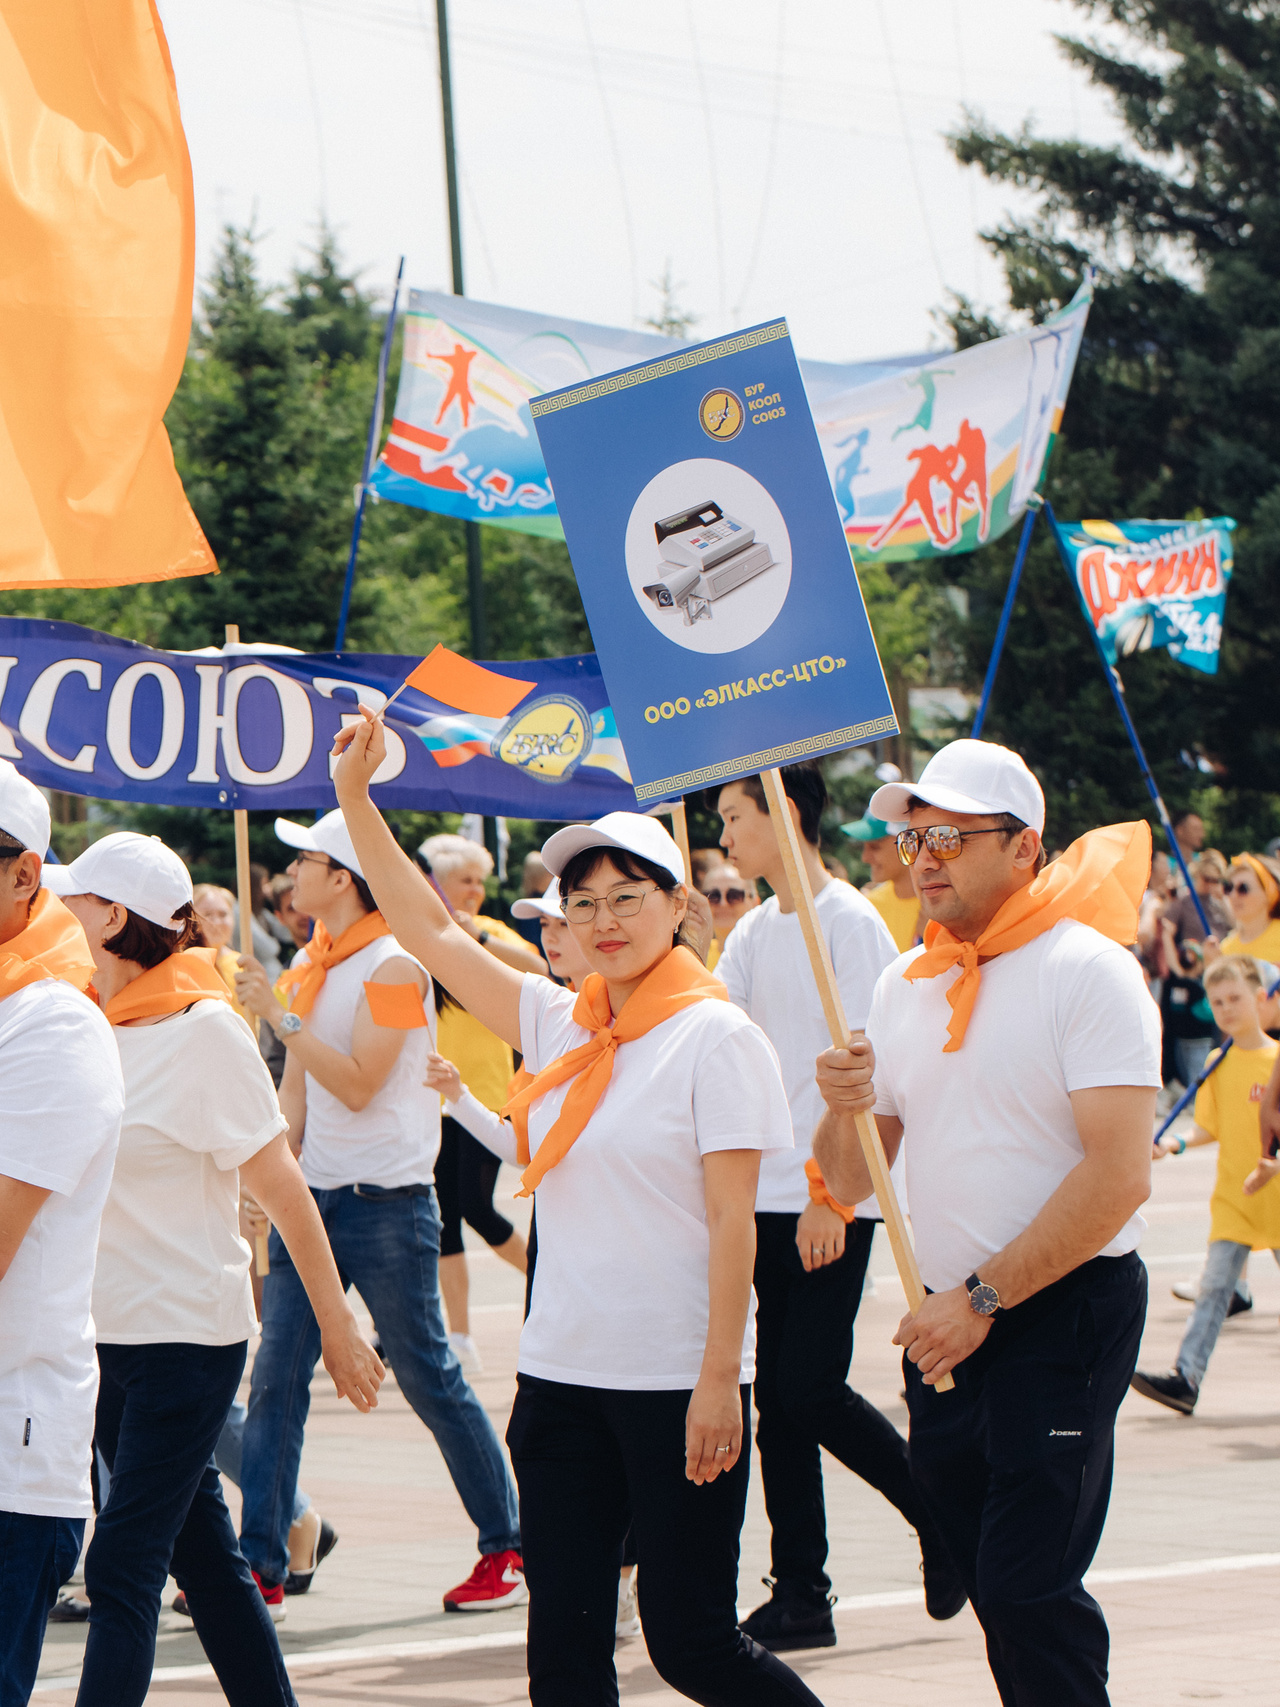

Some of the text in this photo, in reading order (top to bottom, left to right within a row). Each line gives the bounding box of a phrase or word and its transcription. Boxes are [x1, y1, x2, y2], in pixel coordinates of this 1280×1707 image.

[744, 383, 765, 397] БУР
[748, 393, 781, 411] КООП
[752, 407, 786, 425] СОЮЗ
[644, 655, 847, 724] ООО «ЭЛКАСС-ЦТО»
[506, 731, 579, 756] БКС
